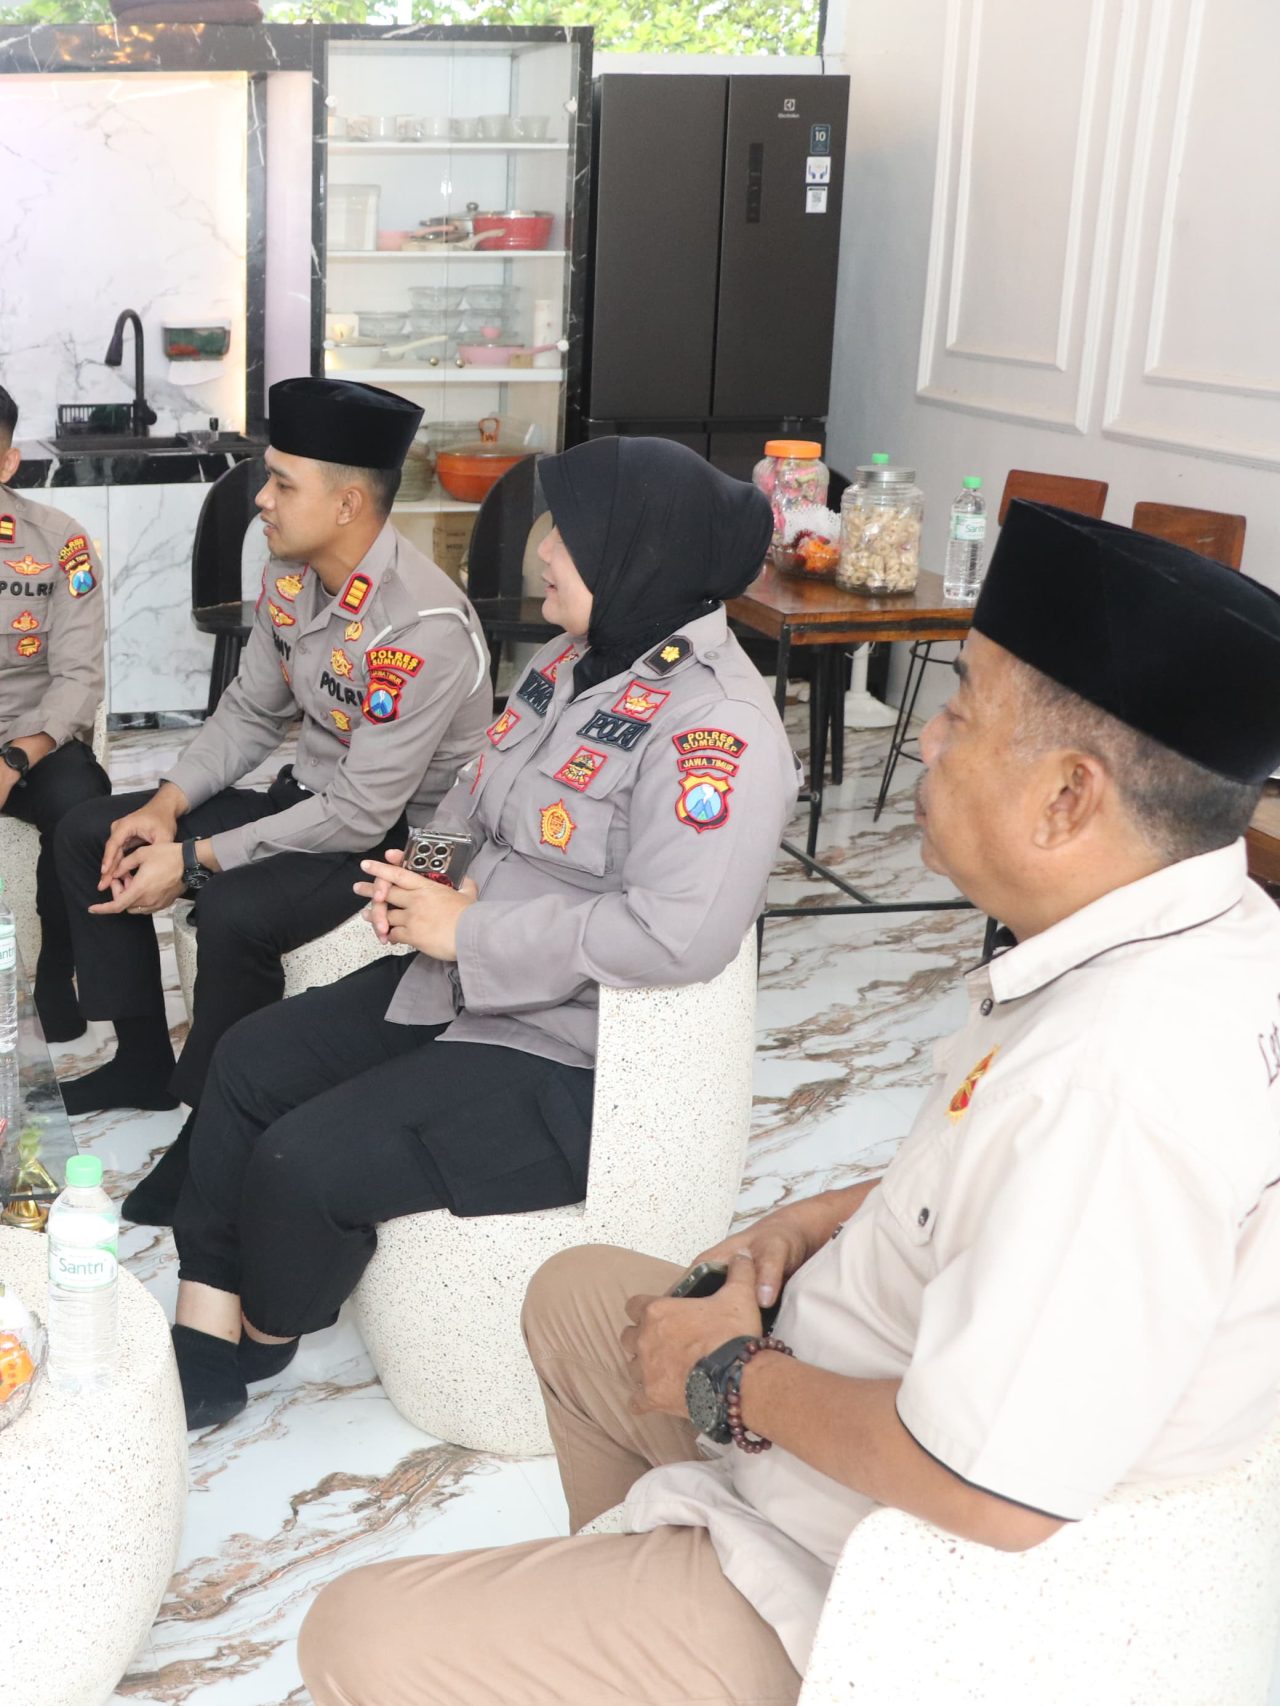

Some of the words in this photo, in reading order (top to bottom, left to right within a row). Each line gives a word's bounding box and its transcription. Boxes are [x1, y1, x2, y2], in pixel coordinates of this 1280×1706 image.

[815, 131, 826, 142] 10
[370, 650, 418, 668] POLRES
[320, 670, 365, 707] POLRI
[687, 731, 735, 744] POLRES
[682, 739, 738, 752] SUMENEP
[683, 758, 707, 768] JAWA
[711, 759, 734, 772] TIMUR
[58, 1257, 103, 1275] Santri
